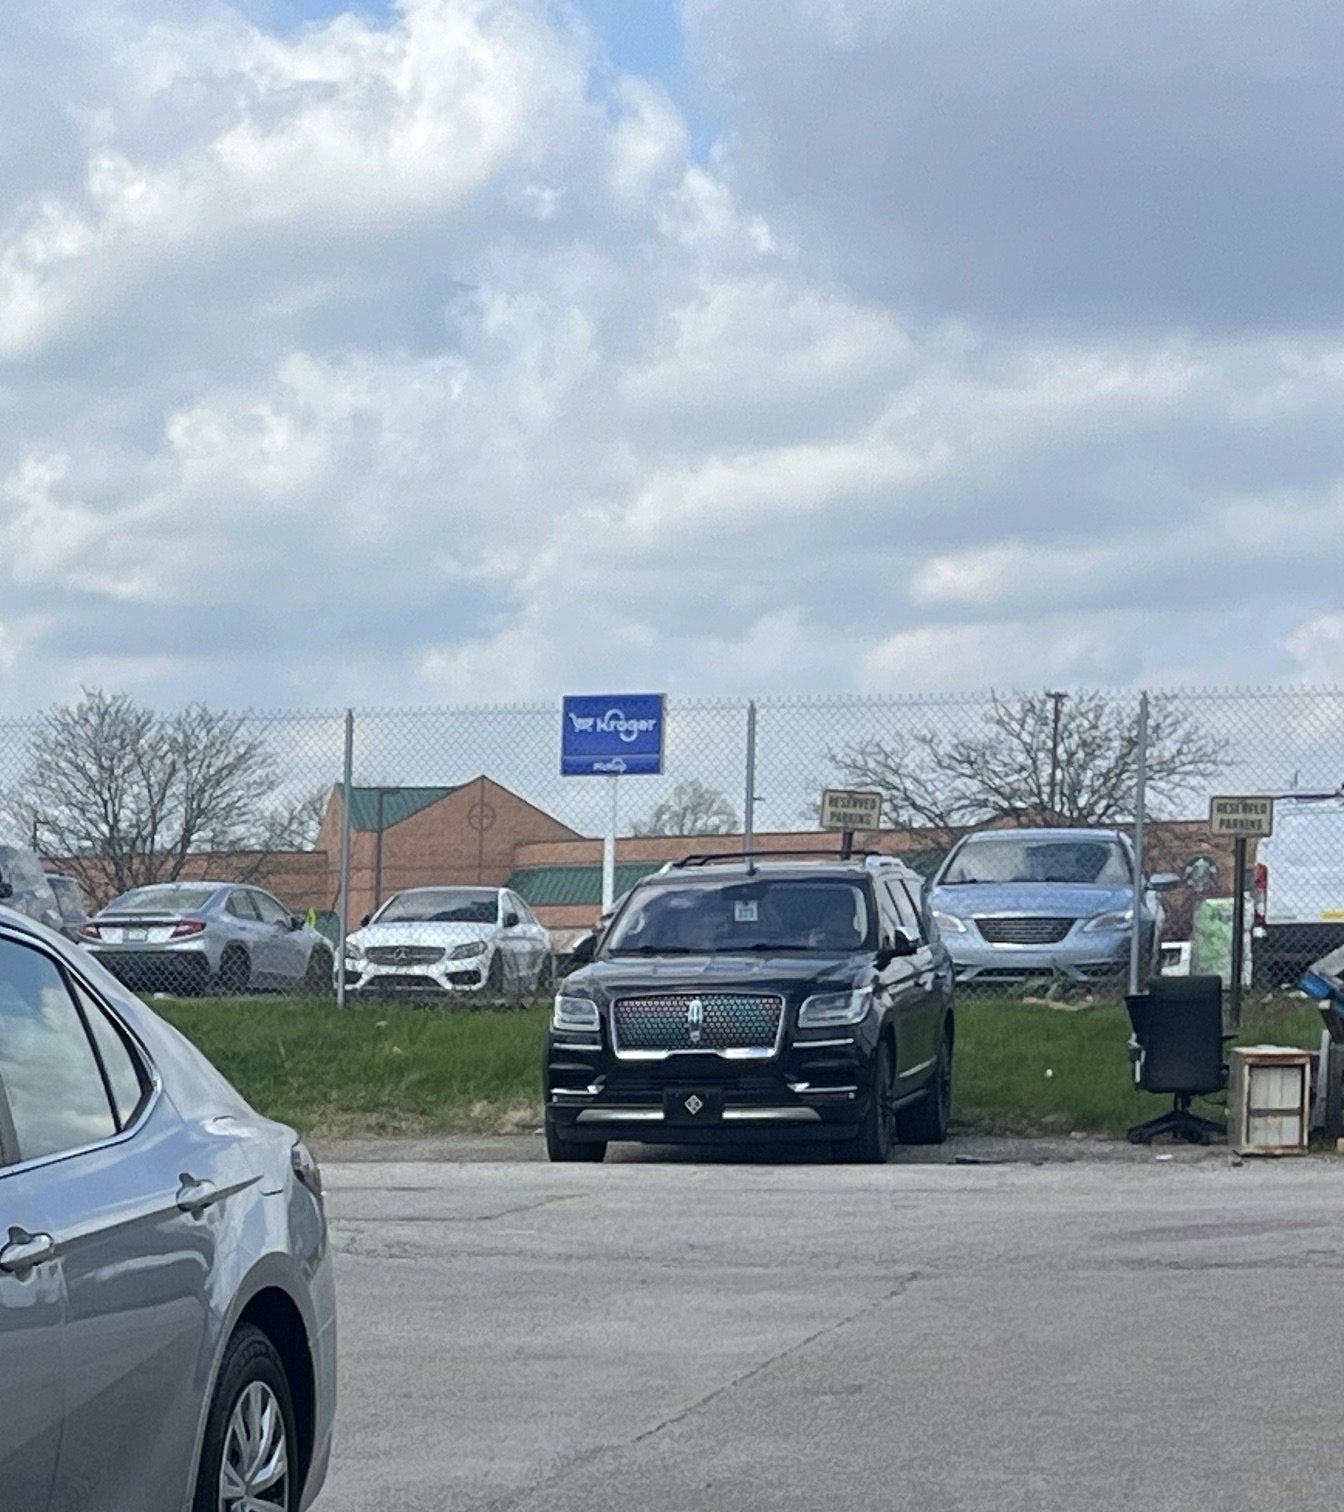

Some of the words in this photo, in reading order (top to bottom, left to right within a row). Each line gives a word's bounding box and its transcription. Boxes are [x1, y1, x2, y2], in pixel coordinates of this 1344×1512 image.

[596, 708, 657, 742] Kroger
[828, 796, 876, 810] RESERVED
[830, 811, 872, 825] PARKING
[1219, 818, 1263, 830] PARKING
